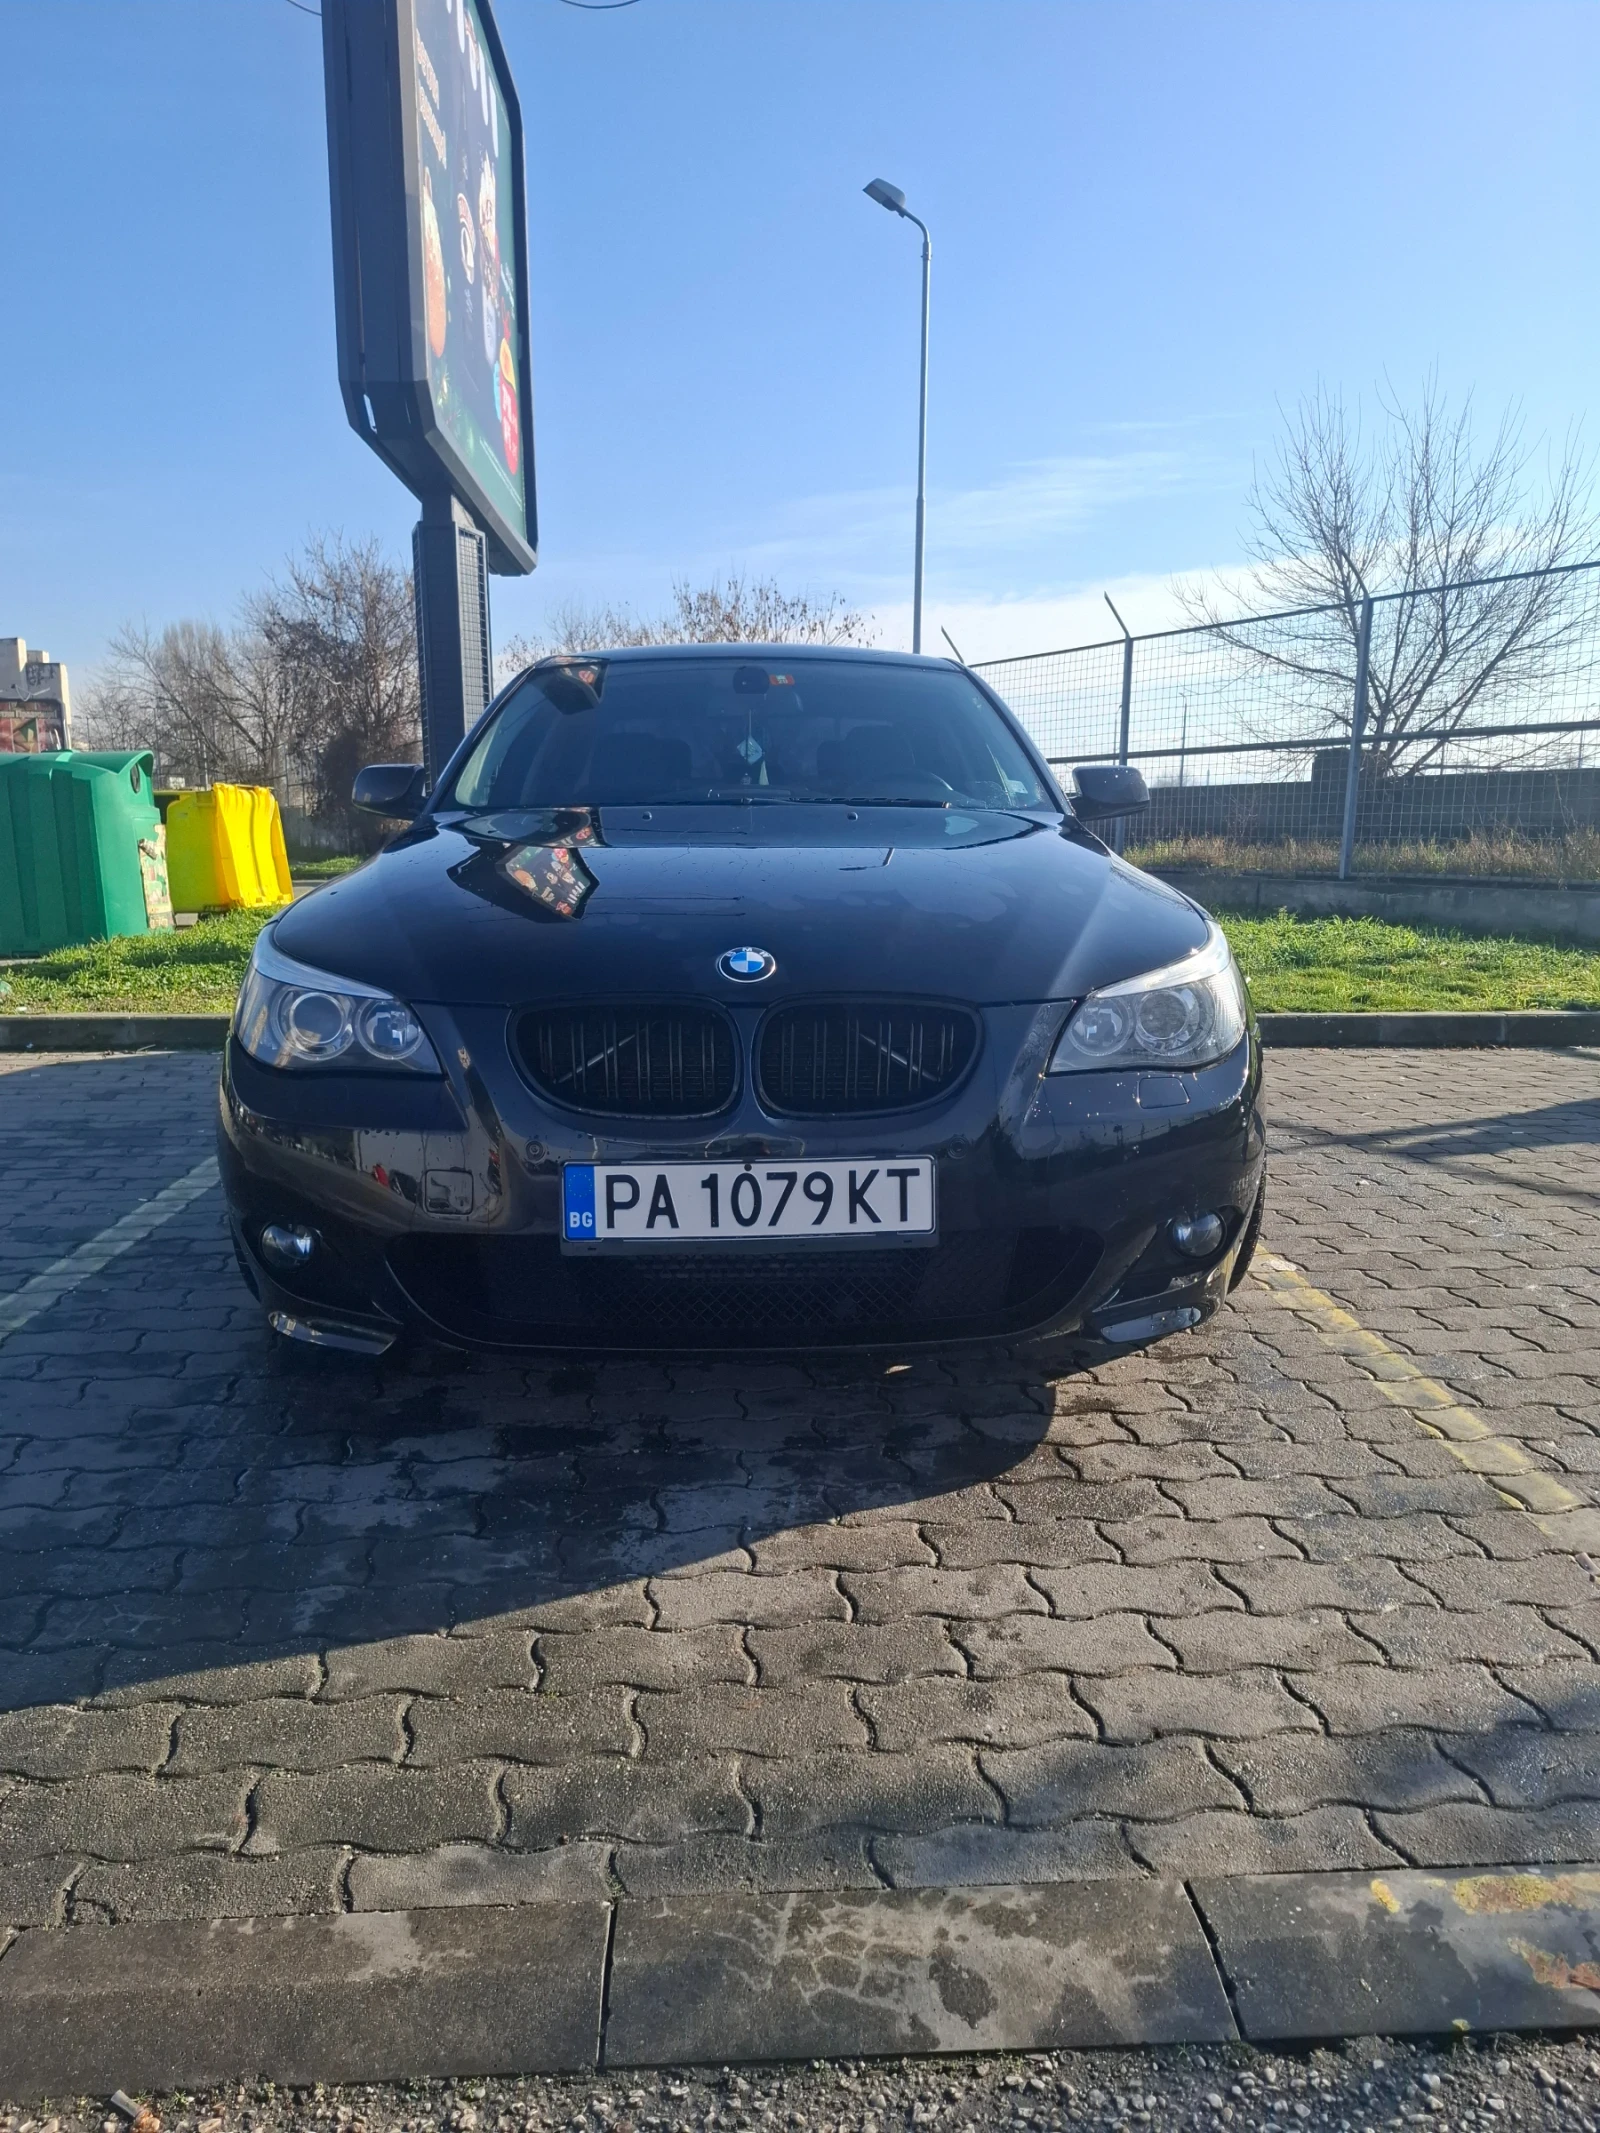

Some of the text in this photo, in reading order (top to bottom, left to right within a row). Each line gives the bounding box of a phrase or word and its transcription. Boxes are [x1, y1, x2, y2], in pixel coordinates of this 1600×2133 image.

[605, 1167, 921, 1229] PA 1079 KT
[570, 1211, 593, 1228] BG
